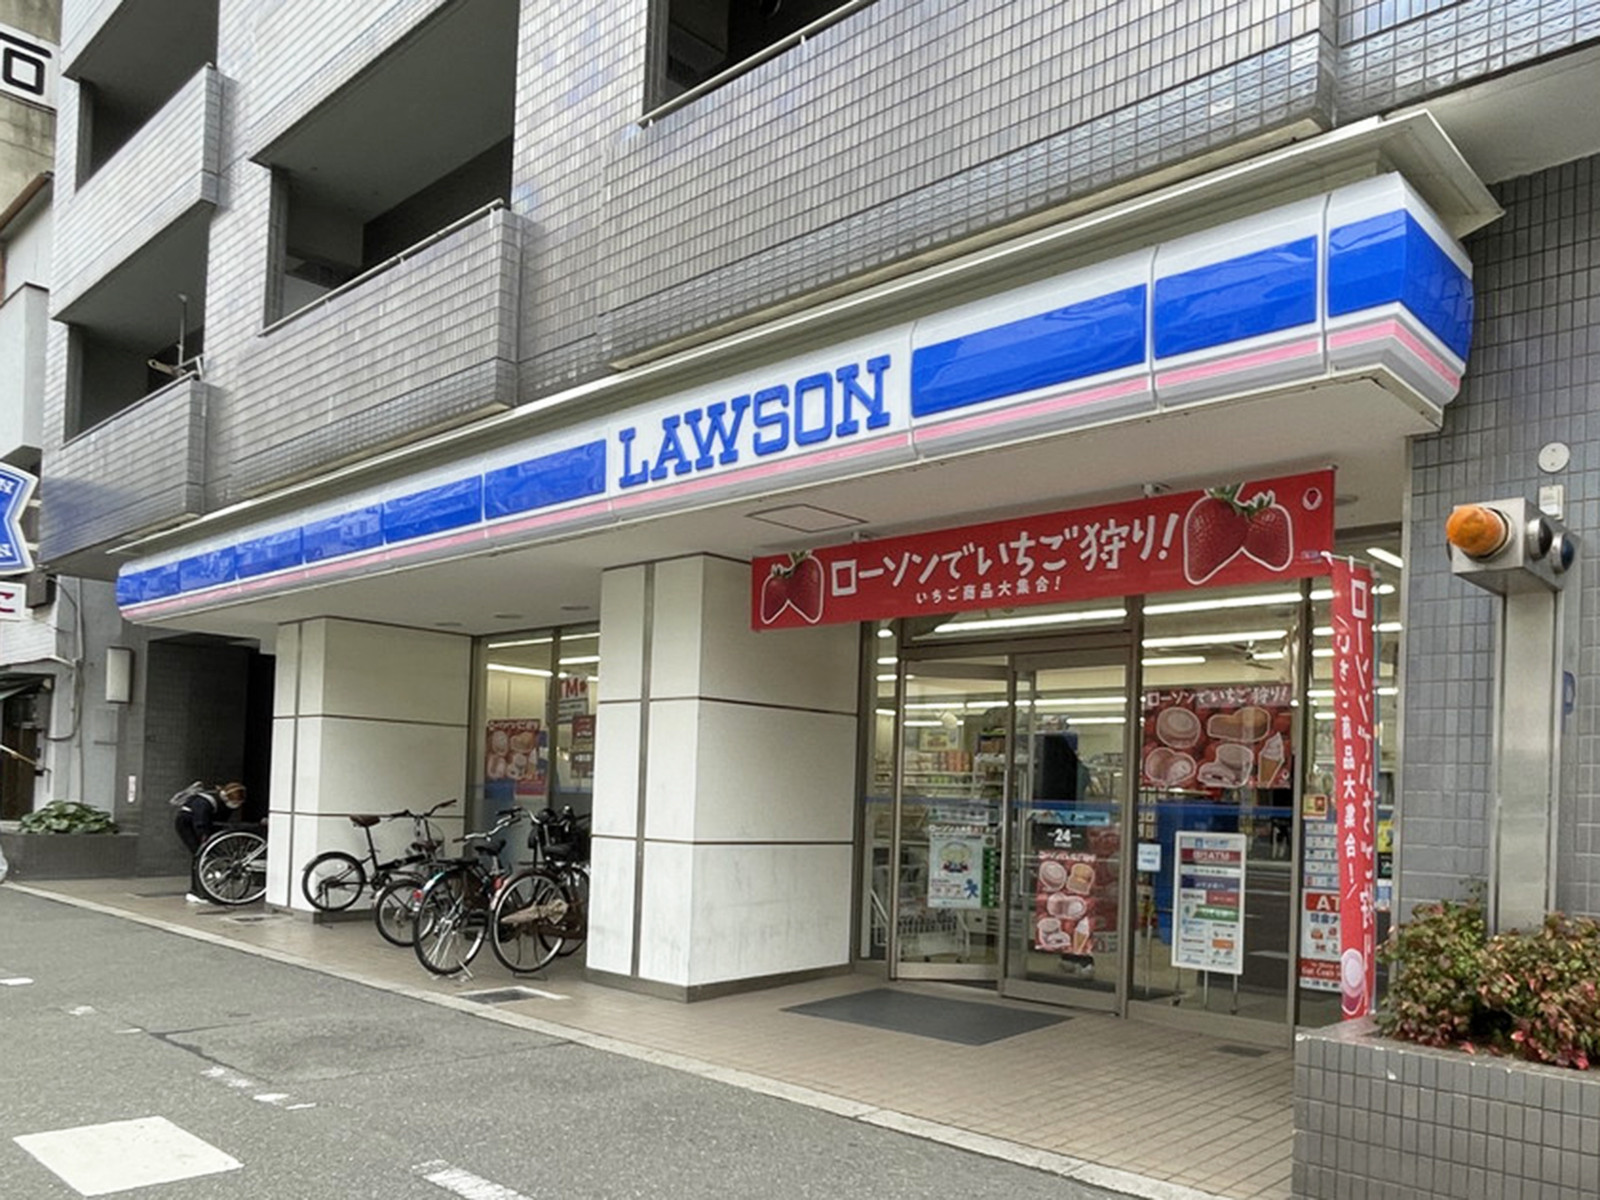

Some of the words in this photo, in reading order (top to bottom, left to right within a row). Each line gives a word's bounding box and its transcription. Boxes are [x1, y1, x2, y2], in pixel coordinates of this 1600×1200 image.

[618, 354, 891, 488] LAWSON
[830, 512, 1179, 597] ローソンでいちご狩り!
[915, 576, 1061, 605] いちご商品大集合!
[1054, 828, 1072, 842] 24
